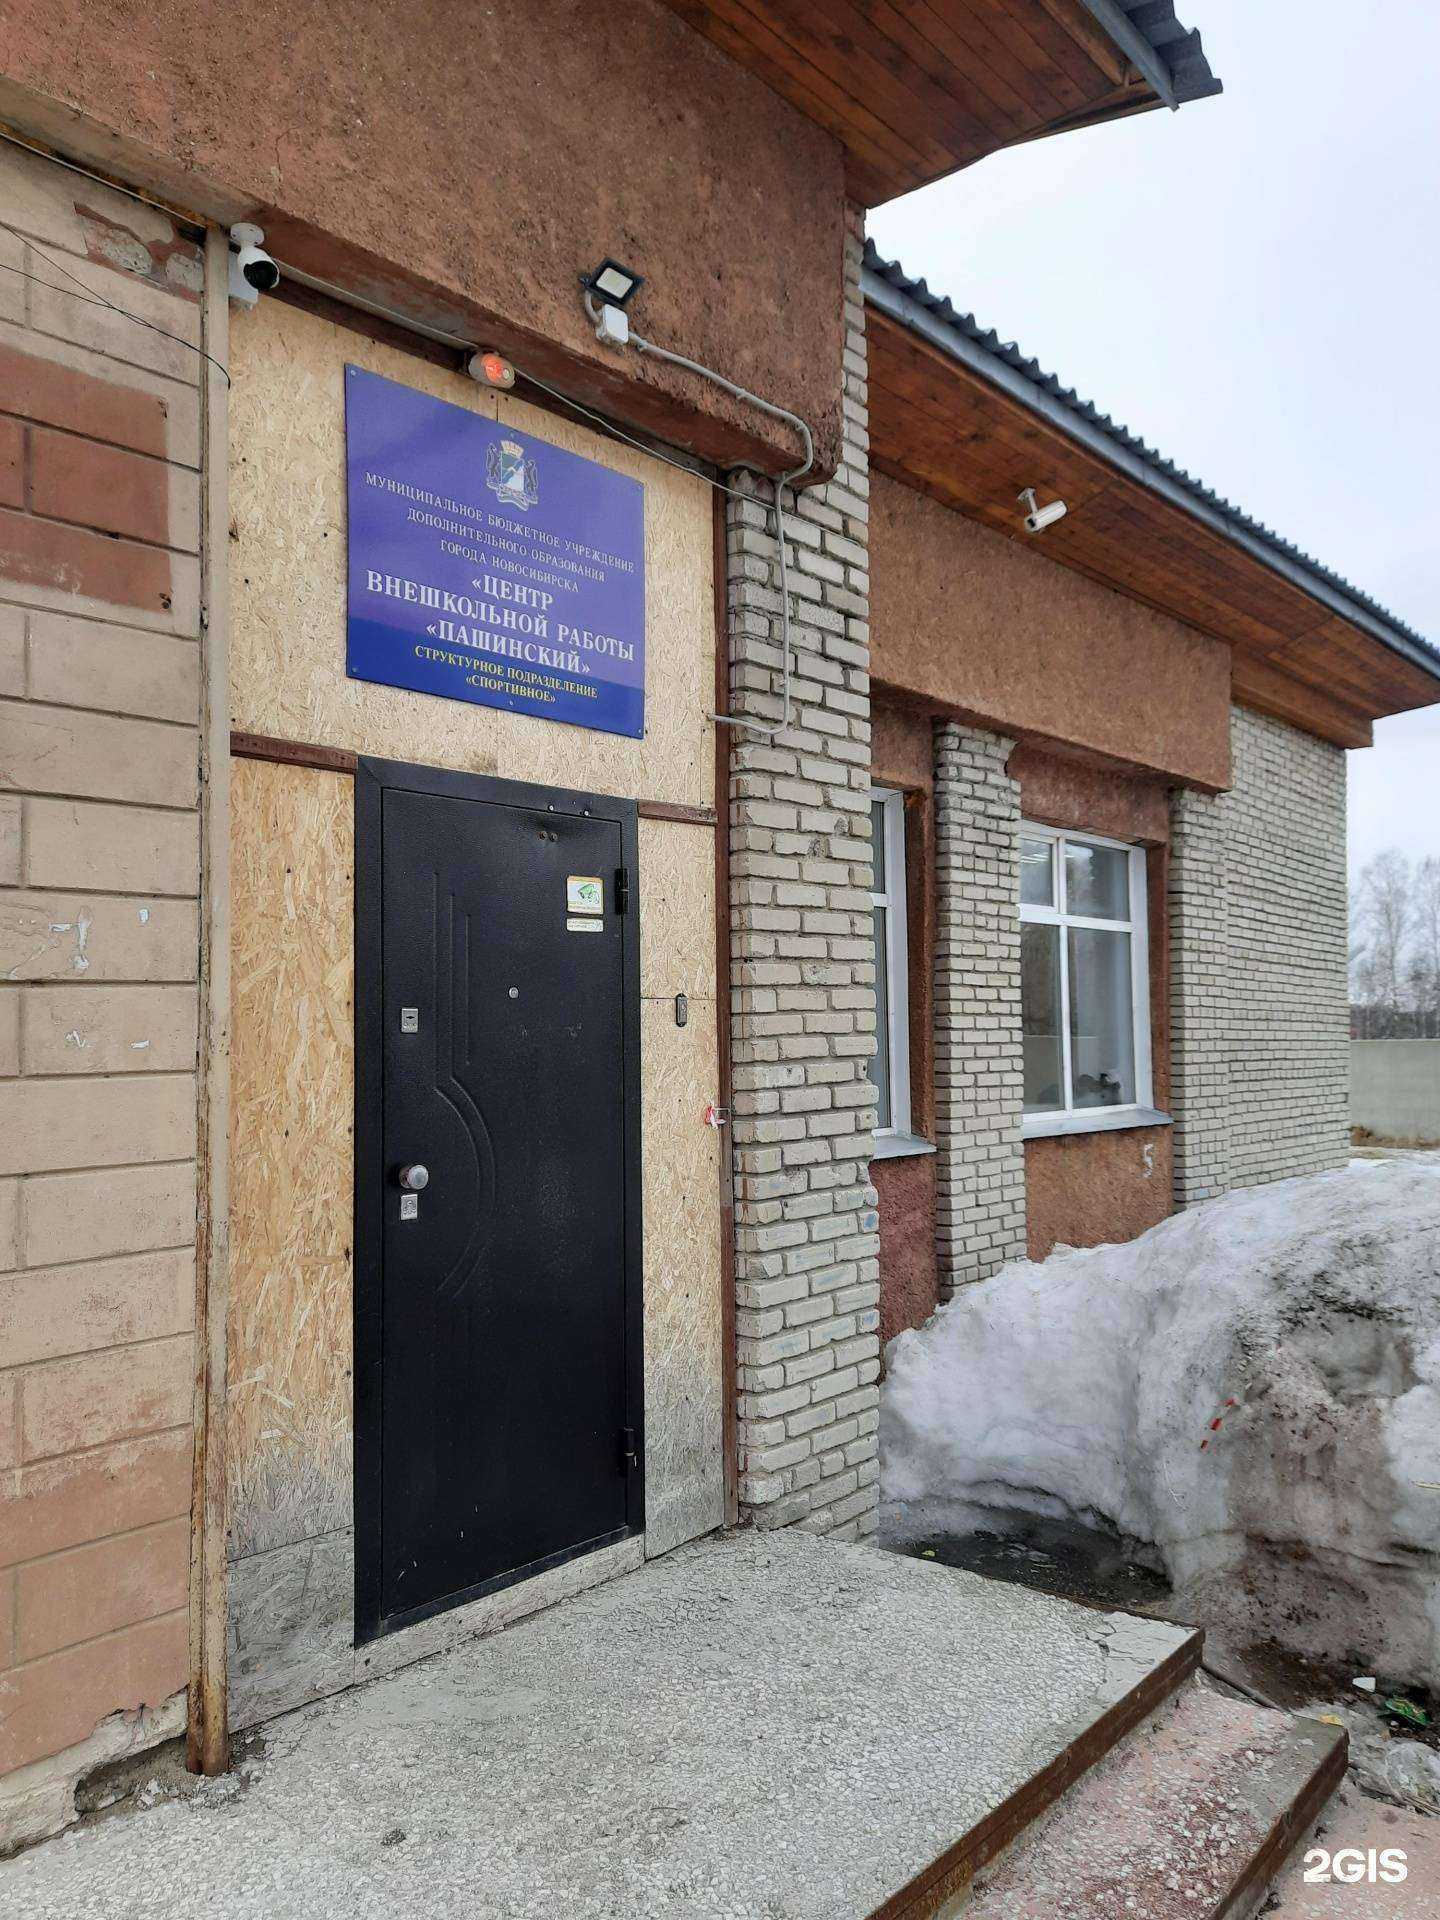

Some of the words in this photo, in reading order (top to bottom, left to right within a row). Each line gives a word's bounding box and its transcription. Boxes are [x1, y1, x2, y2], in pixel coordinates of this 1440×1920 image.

[366, 472, 482, 521] МУНИЦИПАЛЬНОЕ
[488, 514, 560, 546] БЮДЖЕТНОЕ
[565, 540, 634, 573] УЧРЕЖДЕНИЕ
[407, 508, 527, 556] ДОПОЛНИТЕЛЬНОГО
[532, 549, 604, 581] ОБРАЗОВАНИЯ
[441, 540, 486, 564] ГОРОДА
[492, 557, 579, 592] НОВОСИБИРСКА
[472, 574, 553, 611] «ЦЕНТР
[367, 569, 548, 638] ВНЕШКОЛЬНОЙ
[558, 624, 634, 661] РАБОТЫ
[415, 645, 503, 675] СТРУКТУРНОЕ
[507, 666, 598, 698] ПОДРАЗДЕЛЕНИЕ
[426, 620, 590, 675] «ПАШИНСКИЙ»
[466, 674, 556, 703] «СПОРТИВНОЕ»
